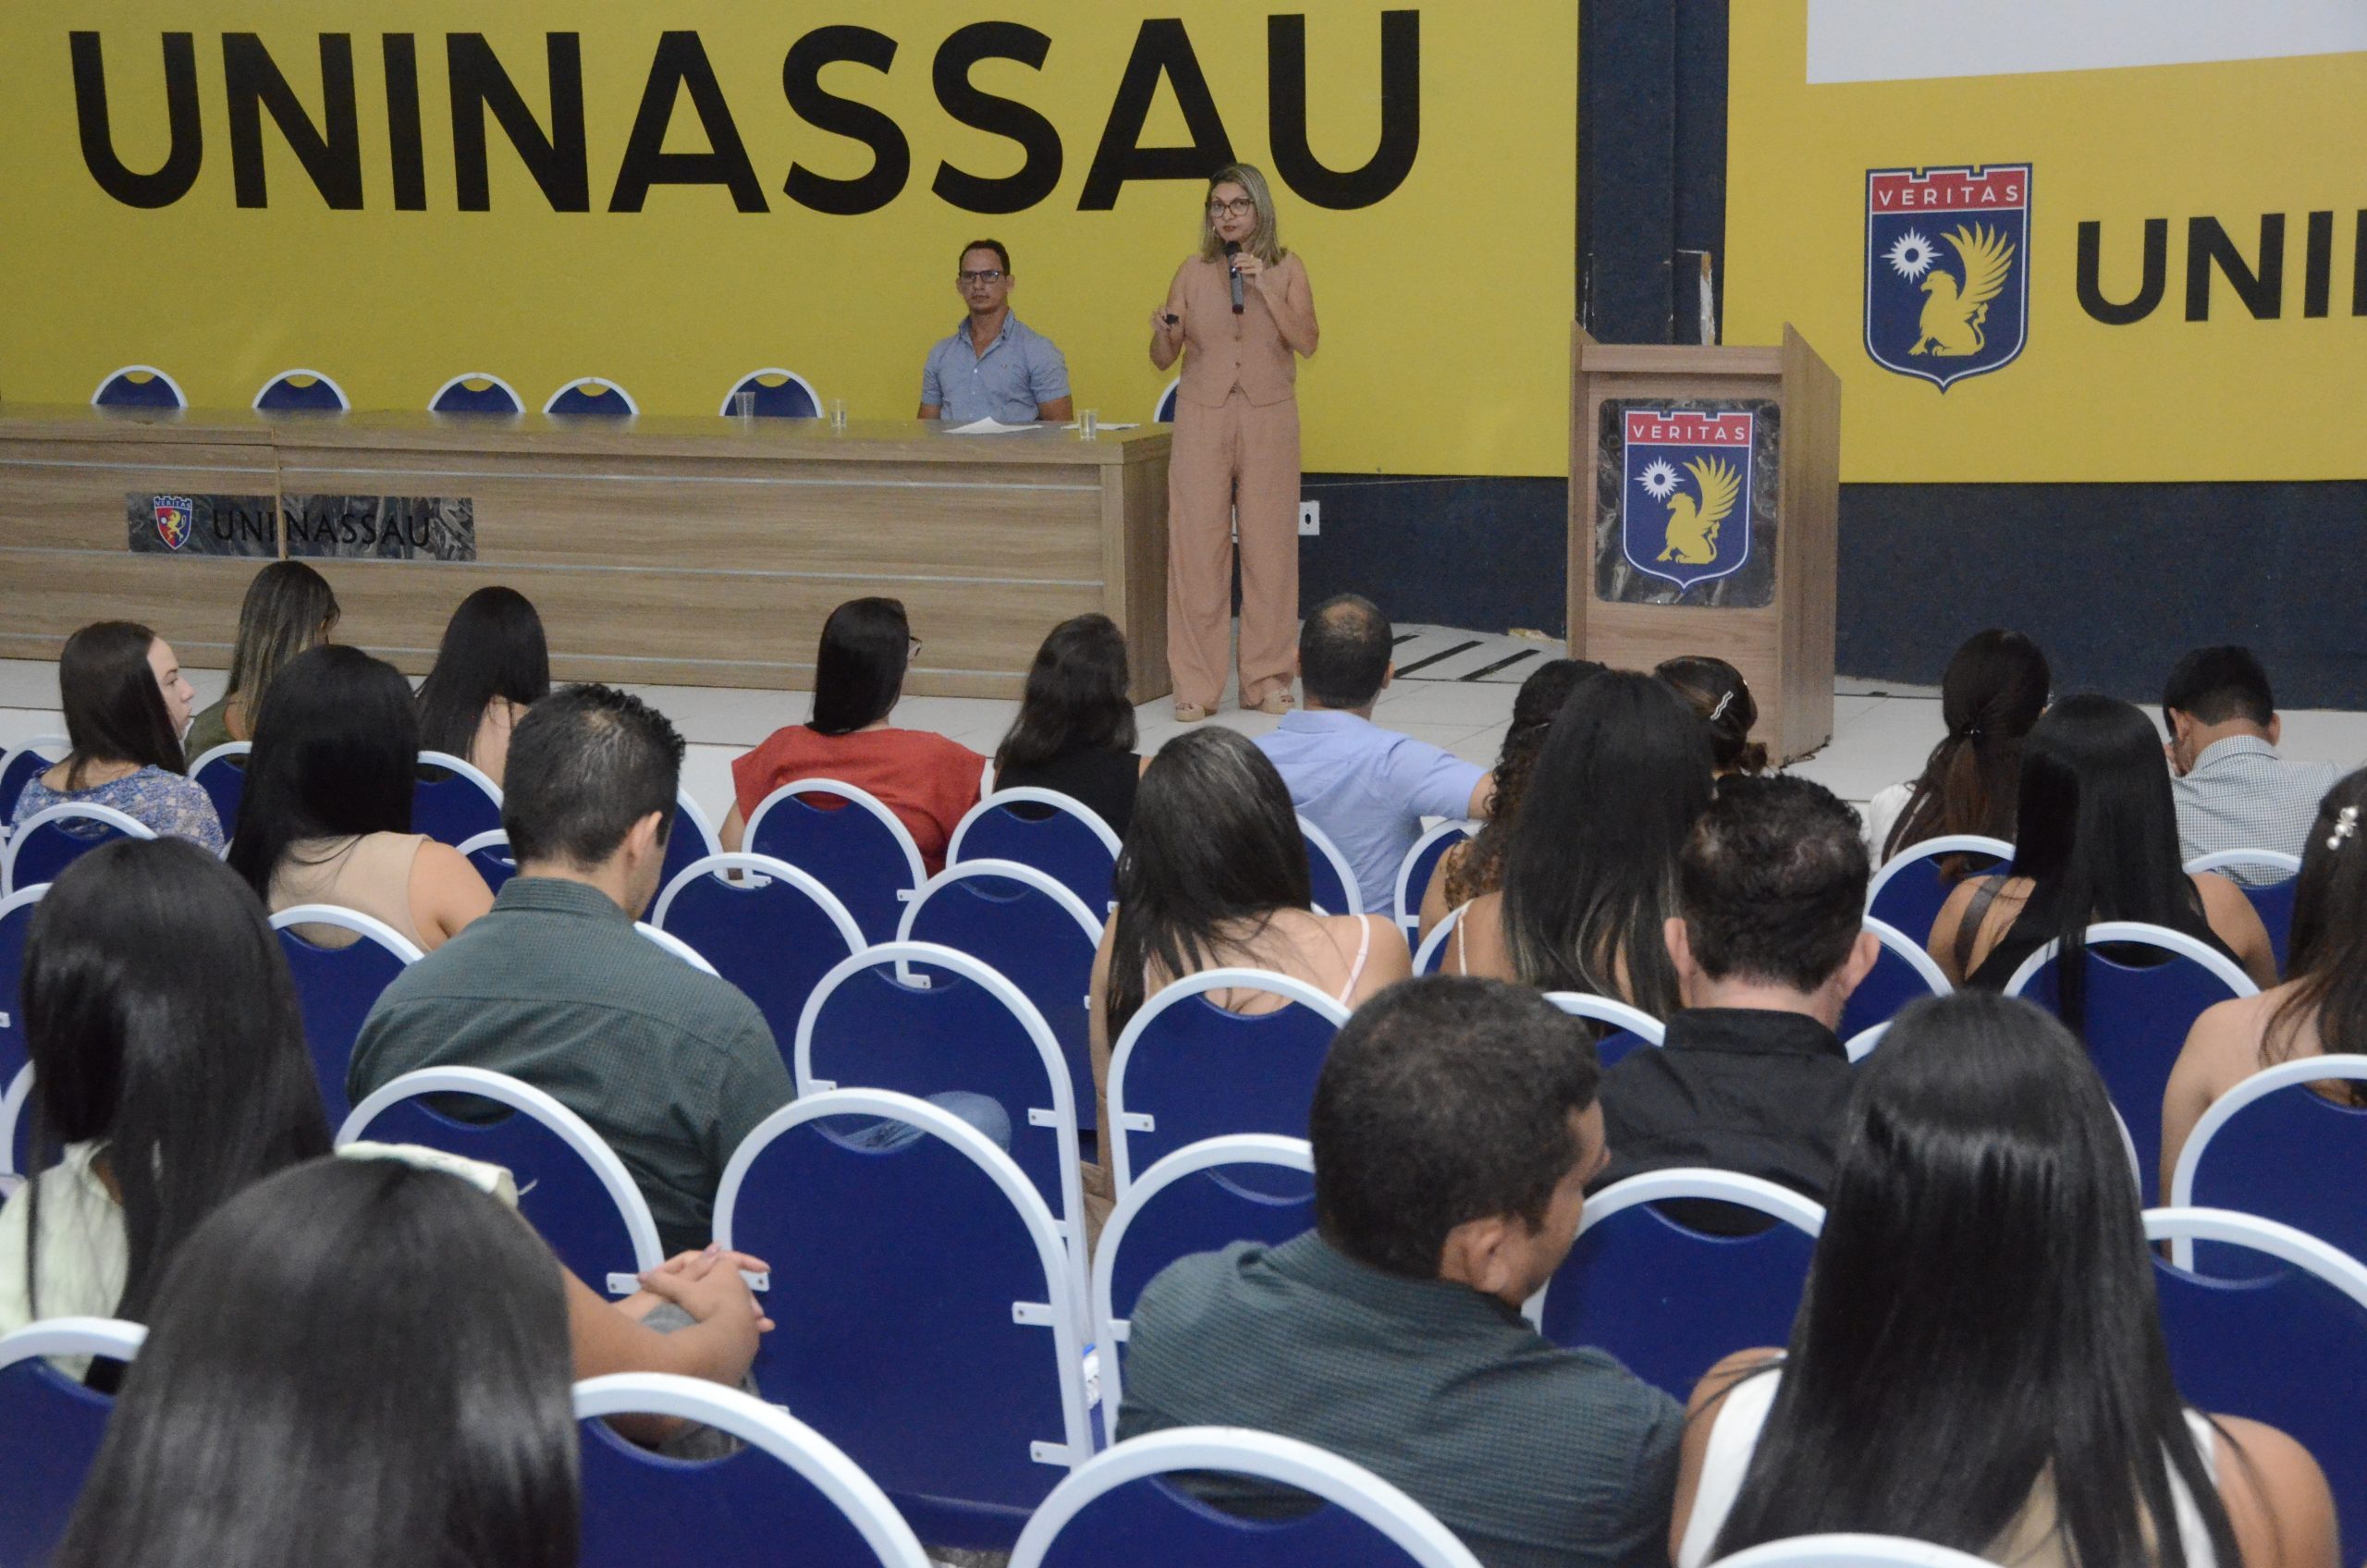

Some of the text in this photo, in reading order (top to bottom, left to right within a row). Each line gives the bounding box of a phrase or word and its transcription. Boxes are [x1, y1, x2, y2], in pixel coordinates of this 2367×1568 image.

[69, 9, 1420, 215] UNINASSAU
[1878, 184, 2018, 206] VERITAS
[2076, 208, 2367, 325] UNI
[1632, 424, 1745, 441] VERITAS
[212, 508, 431, 547] UNINASSAU
